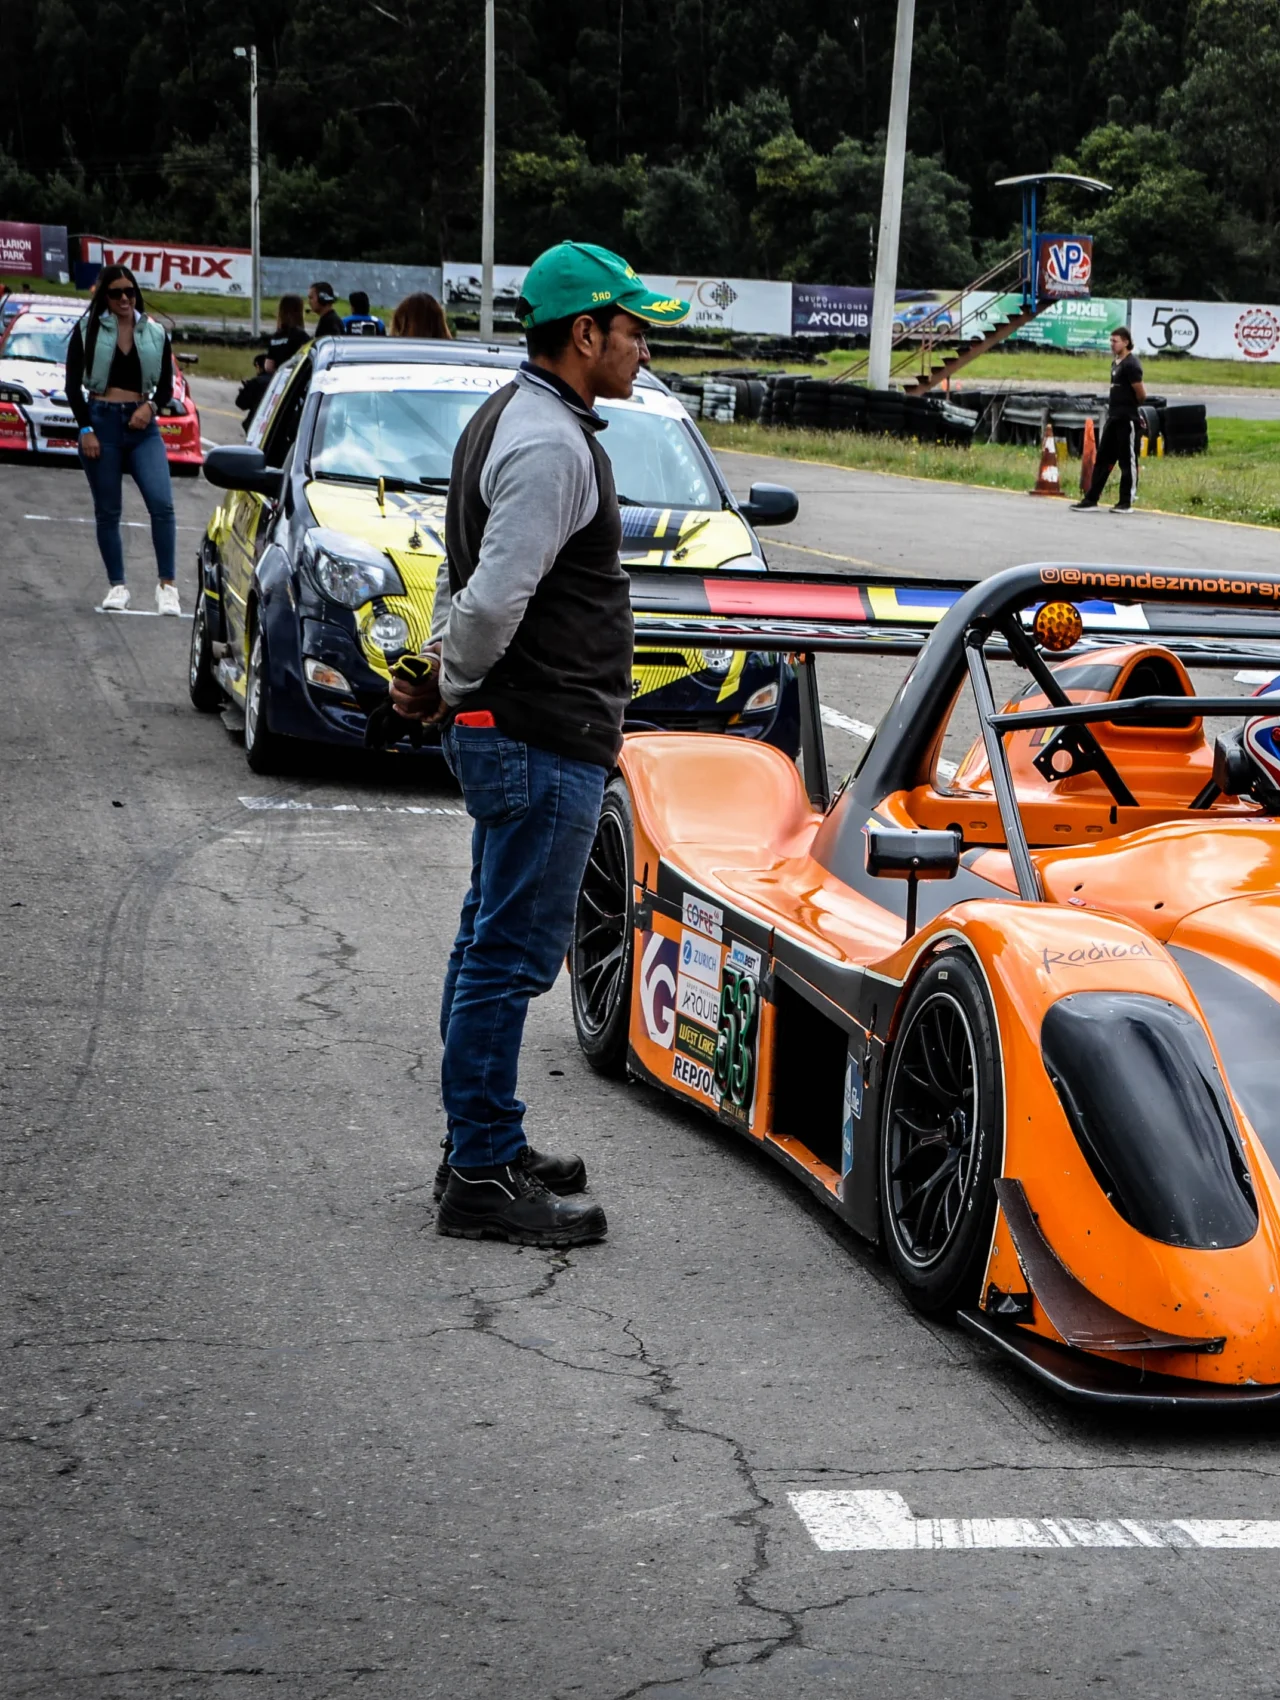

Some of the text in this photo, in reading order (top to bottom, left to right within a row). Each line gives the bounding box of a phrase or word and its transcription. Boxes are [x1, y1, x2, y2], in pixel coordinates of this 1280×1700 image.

[3, 250, 25, 261] PARK
[1049, 241, 1084, 282] VP
[102, 248, 233, 288] VITRIX
[591, 290, 611, 302] 3RD
[799, 295, 828, 303] GRUPO
[813, 302, 868, 311] INVERSIONES
[808, 312, 868, 327] ARQUIB
[1066, 301, 1108, 317] PIXEL
[1147, 307, 1199, 350] 50
[1173, 329, 1193, 337] FCAD
[1242, 328, 1272, 338] FCAD
[686, 903, 713, 935] COFRE
[694, 950, 717, 972] ZURICH
[733, 948, 756, 969] INCOLBEST
[1042, 940, 1153, 974] Radical
[682, 990, 718, 1024] ARQUIB
[679, 1023, 699, 1046] WEST
[698, 1033, 716, 1056] LAKE
